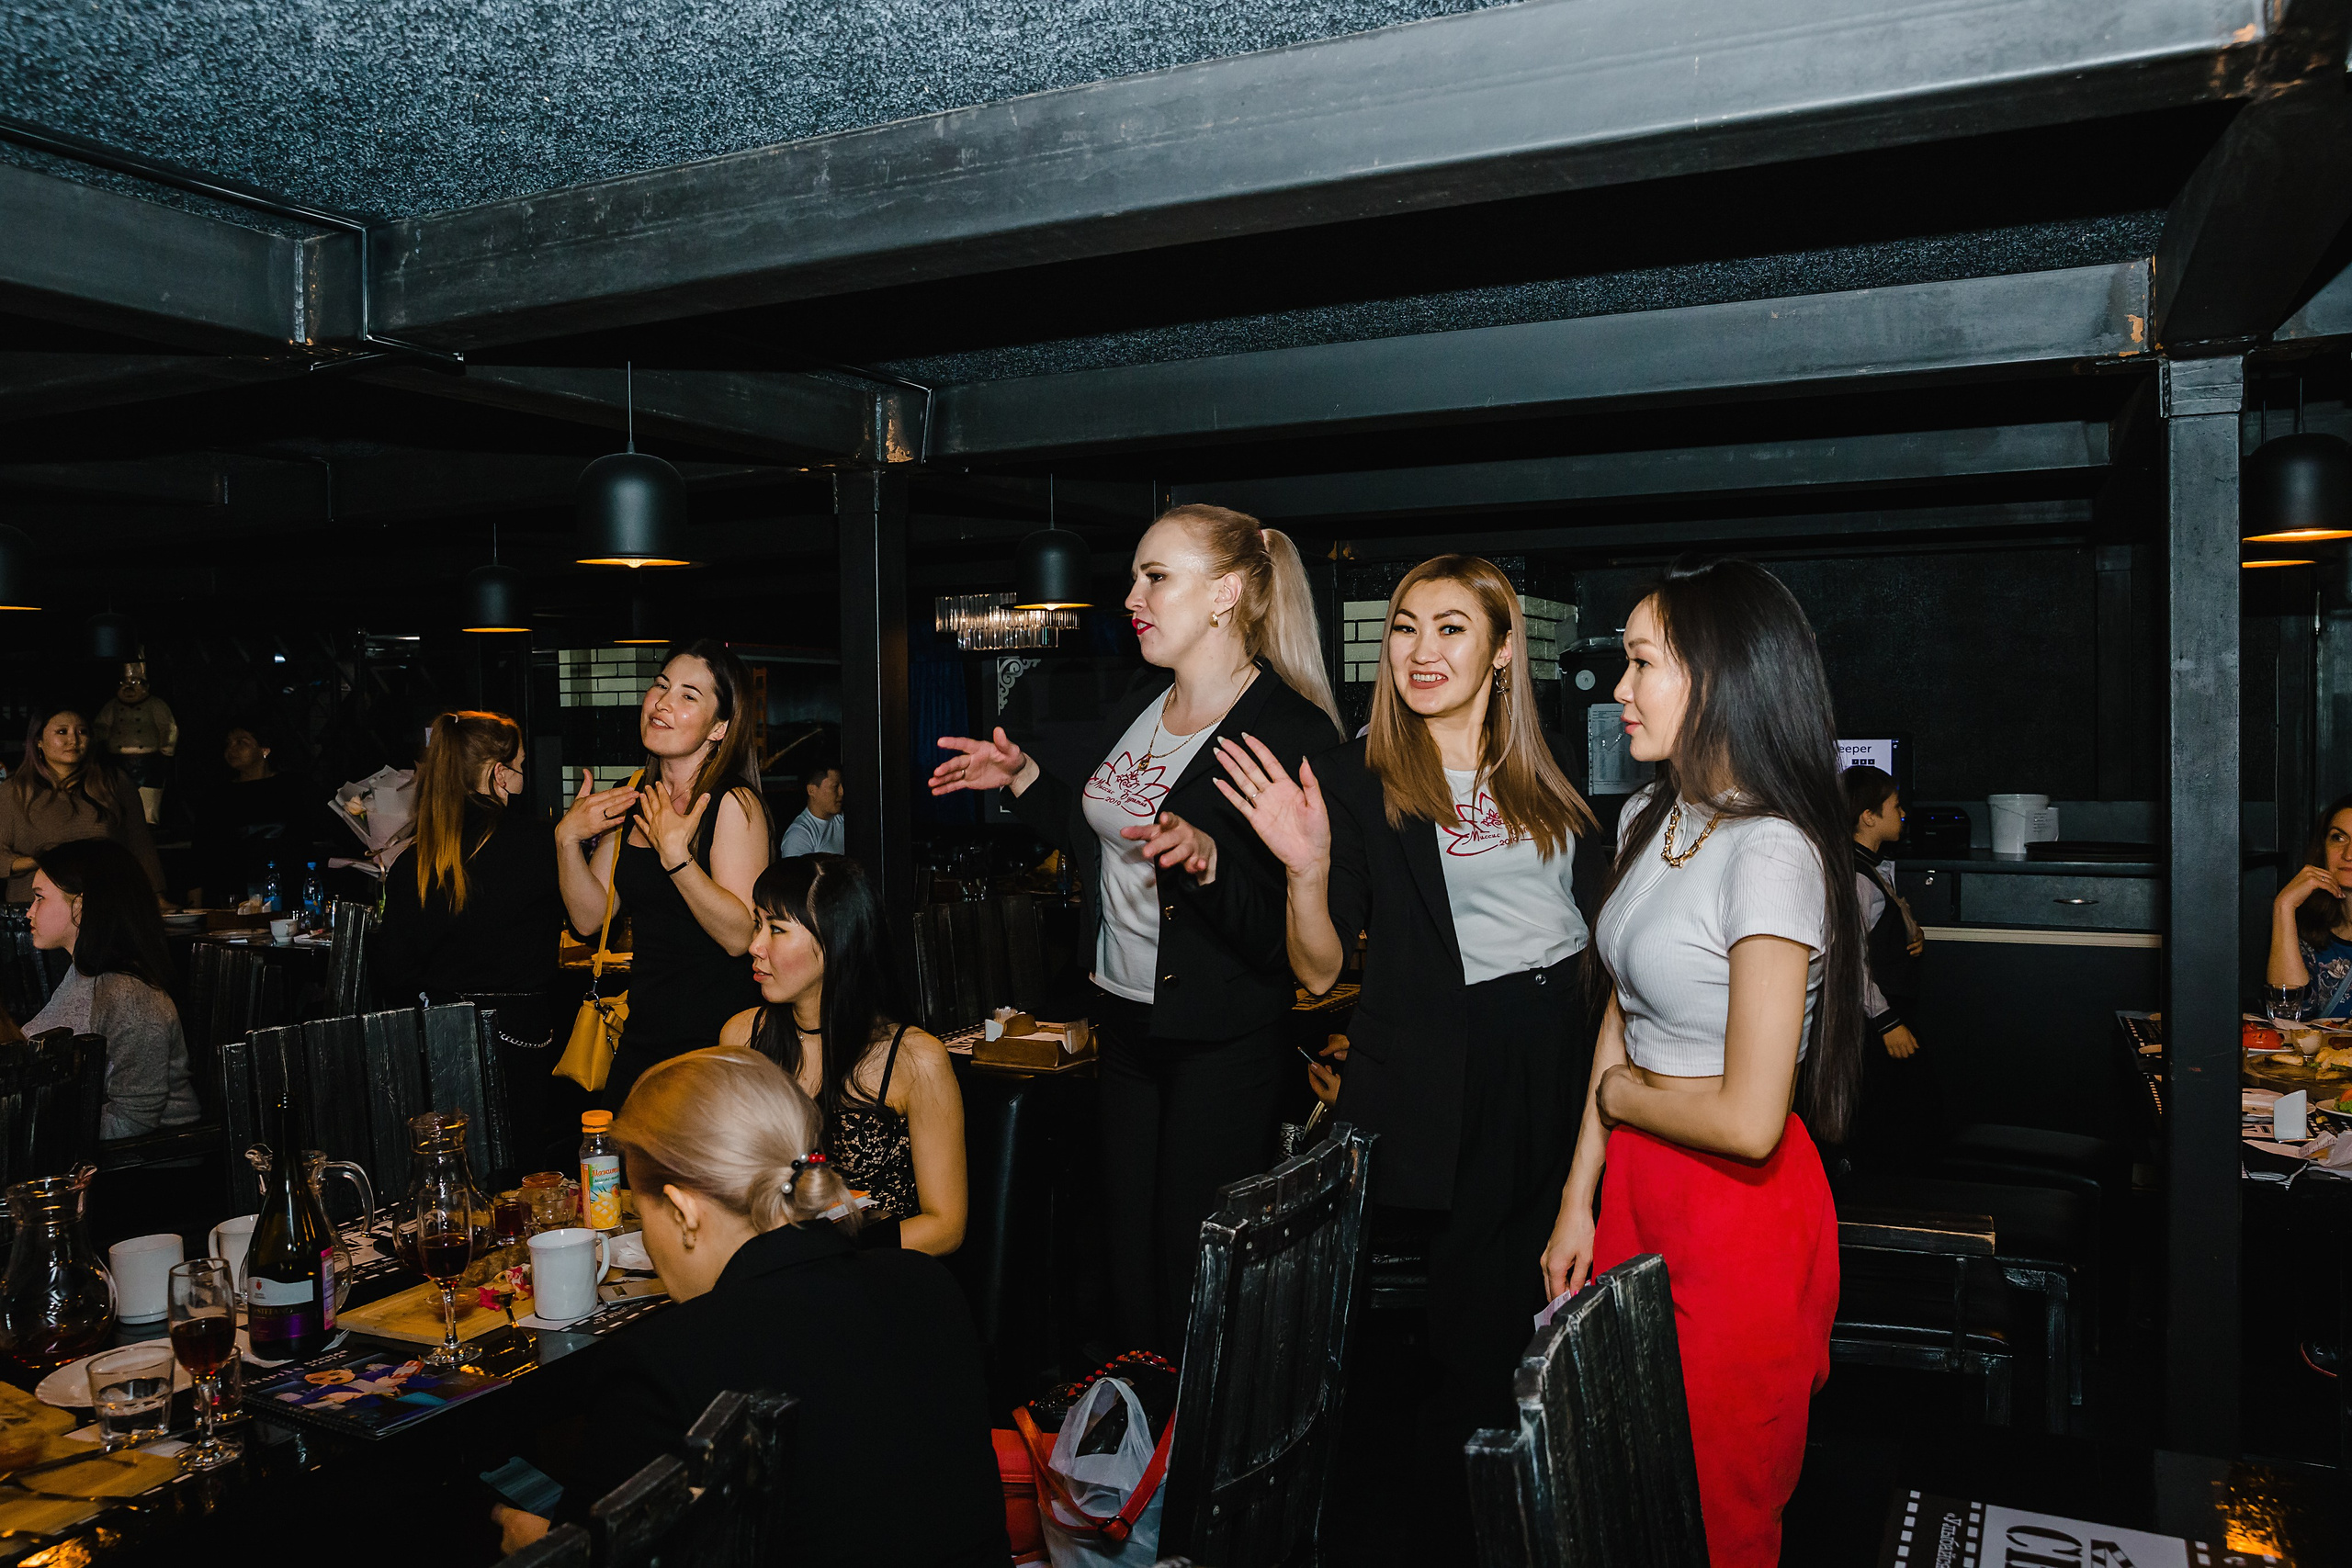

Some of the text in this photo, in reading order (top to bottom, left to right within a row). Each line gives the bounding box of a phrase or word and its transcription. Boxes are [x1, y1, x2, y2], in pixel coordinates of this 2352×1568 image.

[1839, 746, 1871, 755] eeper
[1104, 795, 1122, 807] 2019
[1462, 829, 1500, 845] Миссис
